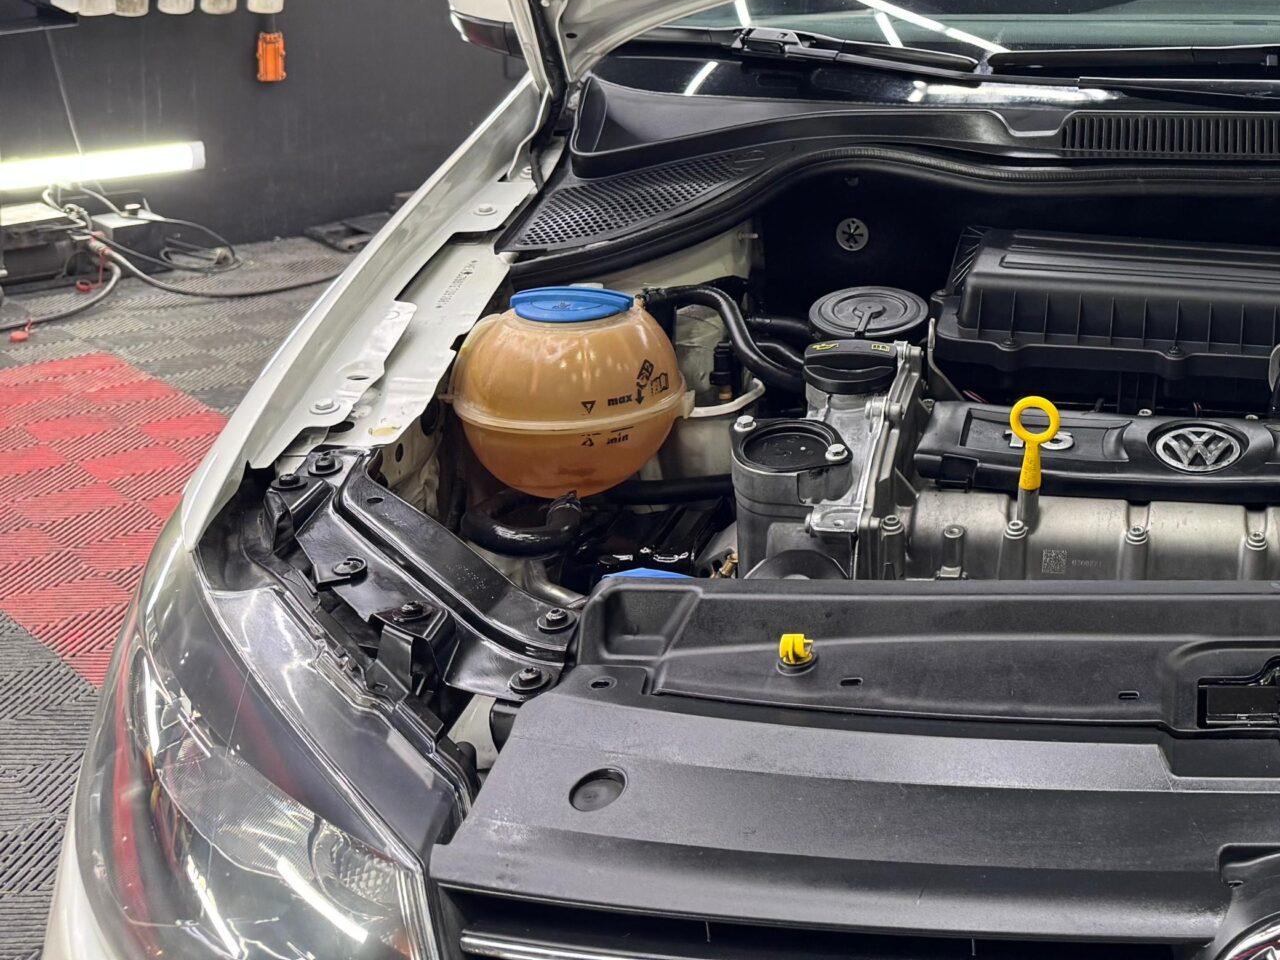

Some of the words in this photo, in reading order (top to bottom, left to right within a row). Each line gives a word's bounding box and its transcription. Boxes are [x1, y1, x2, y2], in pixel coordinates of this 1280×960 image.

[607, 394, 633, 406] max
[606, 432, 629, 445] min
[1003, 429, 1074, 450] 16
